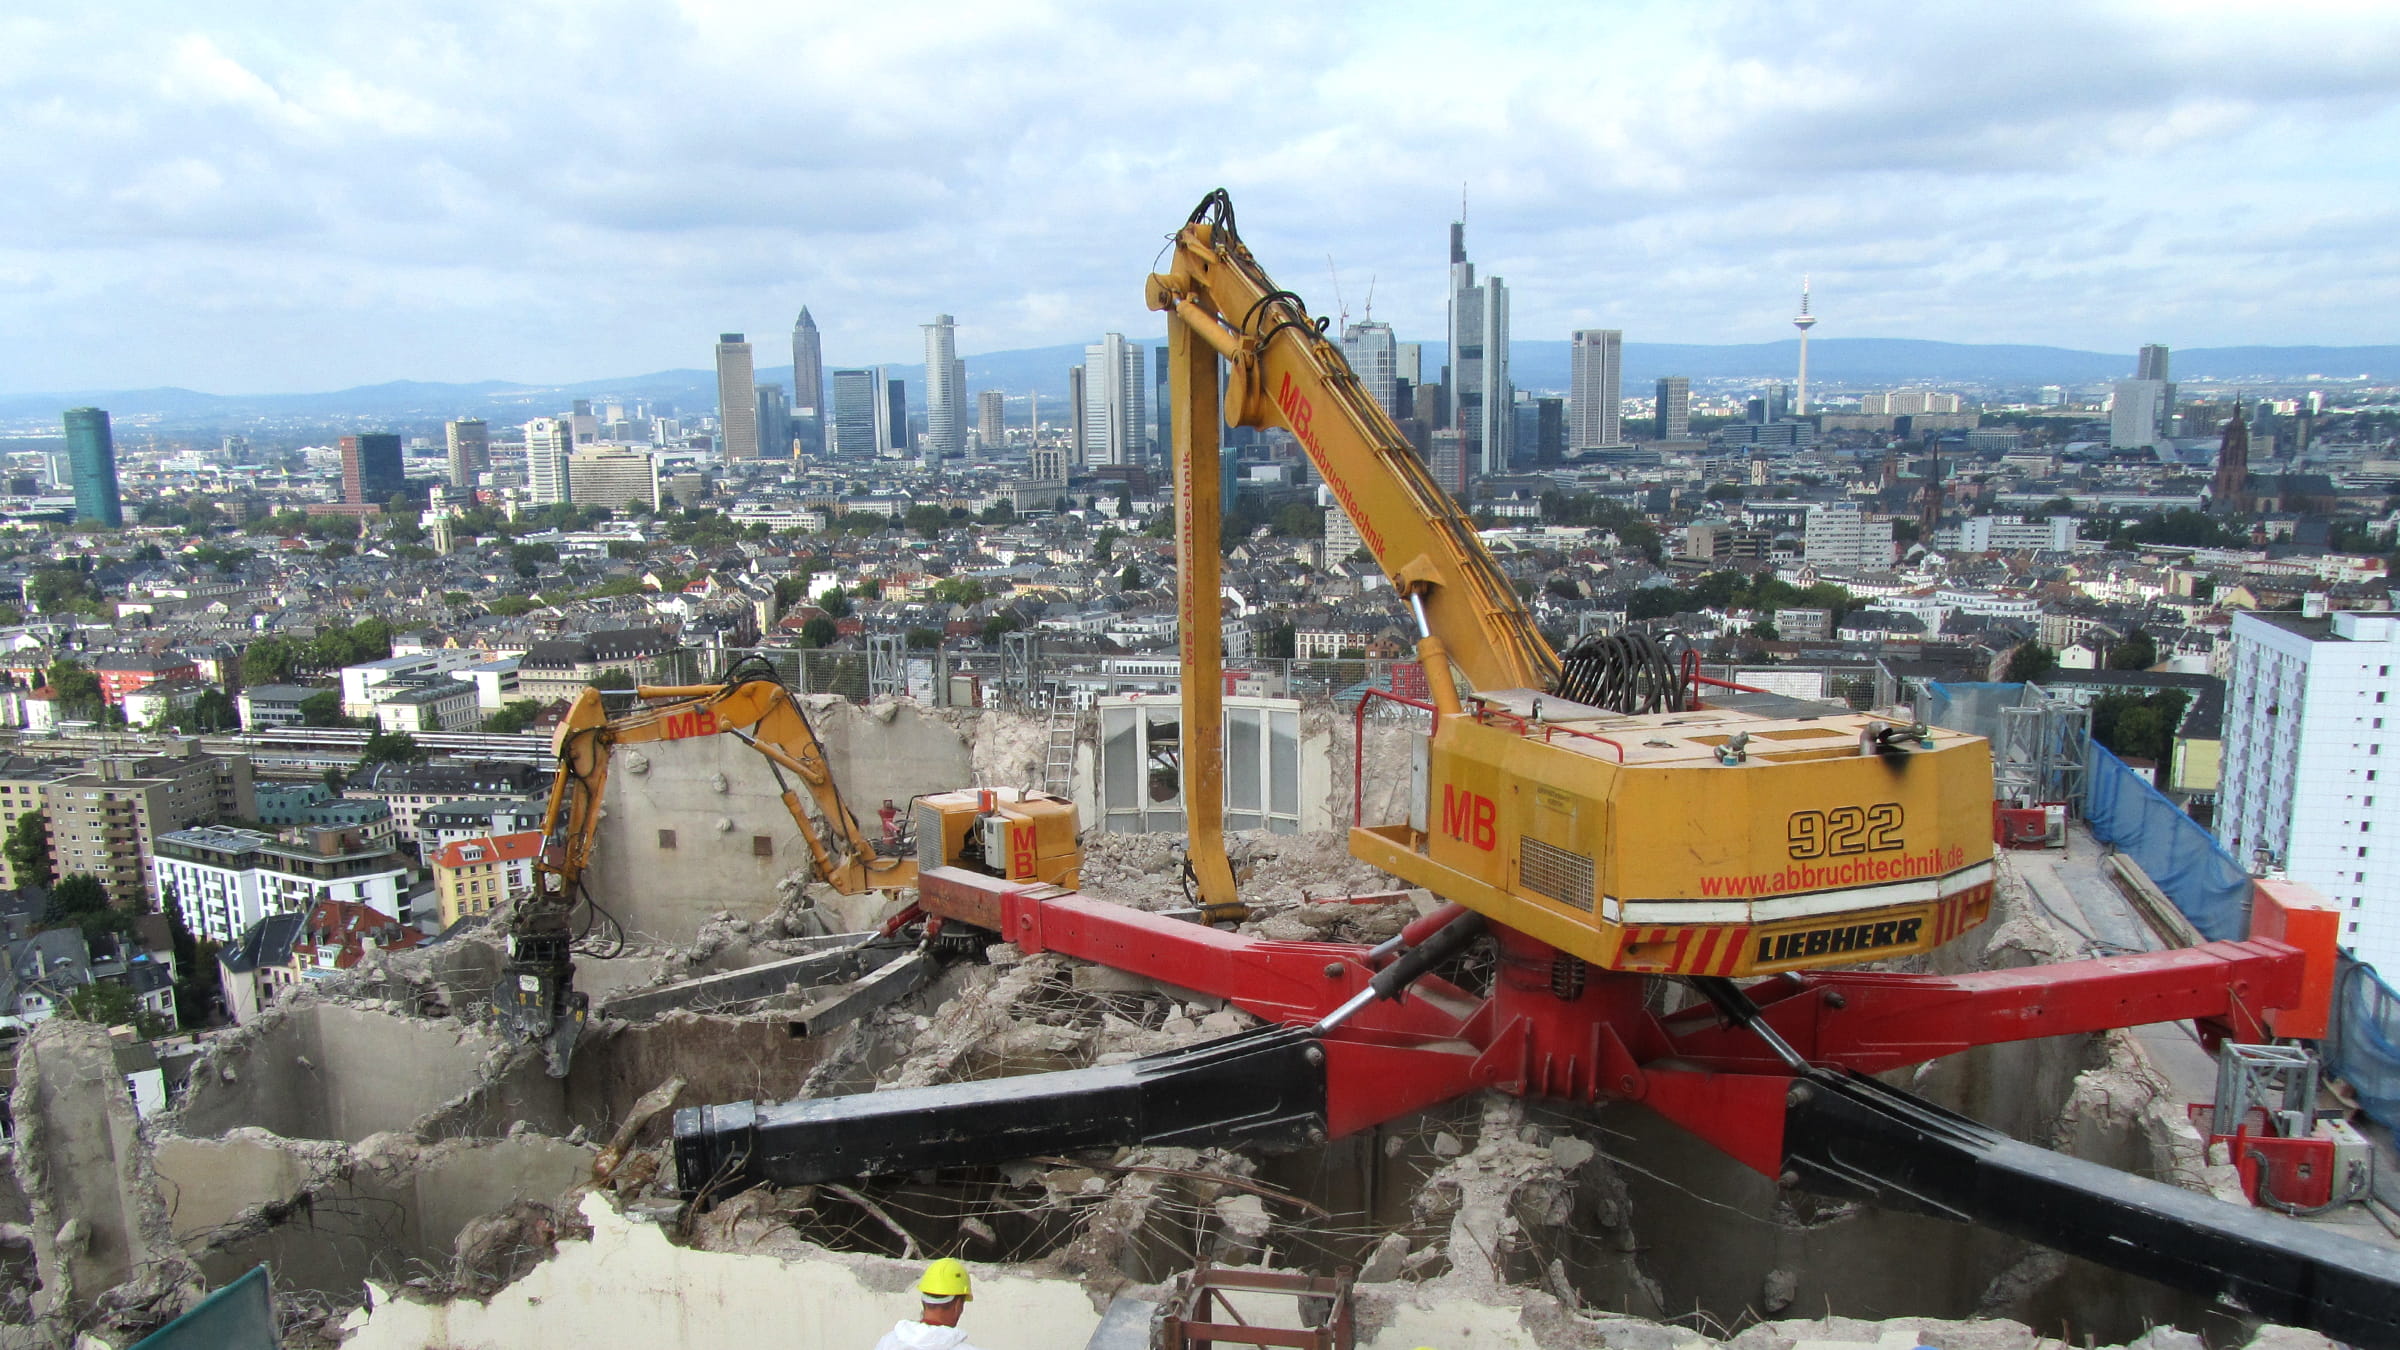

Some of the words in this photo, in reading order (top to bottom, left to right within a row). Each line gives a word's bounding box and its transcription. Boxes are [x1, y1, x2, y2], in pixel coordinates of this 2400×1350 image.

[1279, 371, 1313, 440] MB
[1306, 430, 1386, 561] Abbruchtechnik
[1182, 450, 1194, 625] Abbruchtechnik
[1185, 631, 1194, 666] MB
[667, 708, 717, 741] MB
[1442, 783, 1496, 852] MB
[1787, 802, 1904, 861] 922
[1700, 846, 1965, 897] www.abbruchtechnik.de
[1756, 917, 1923, 963] LIEBHERR
